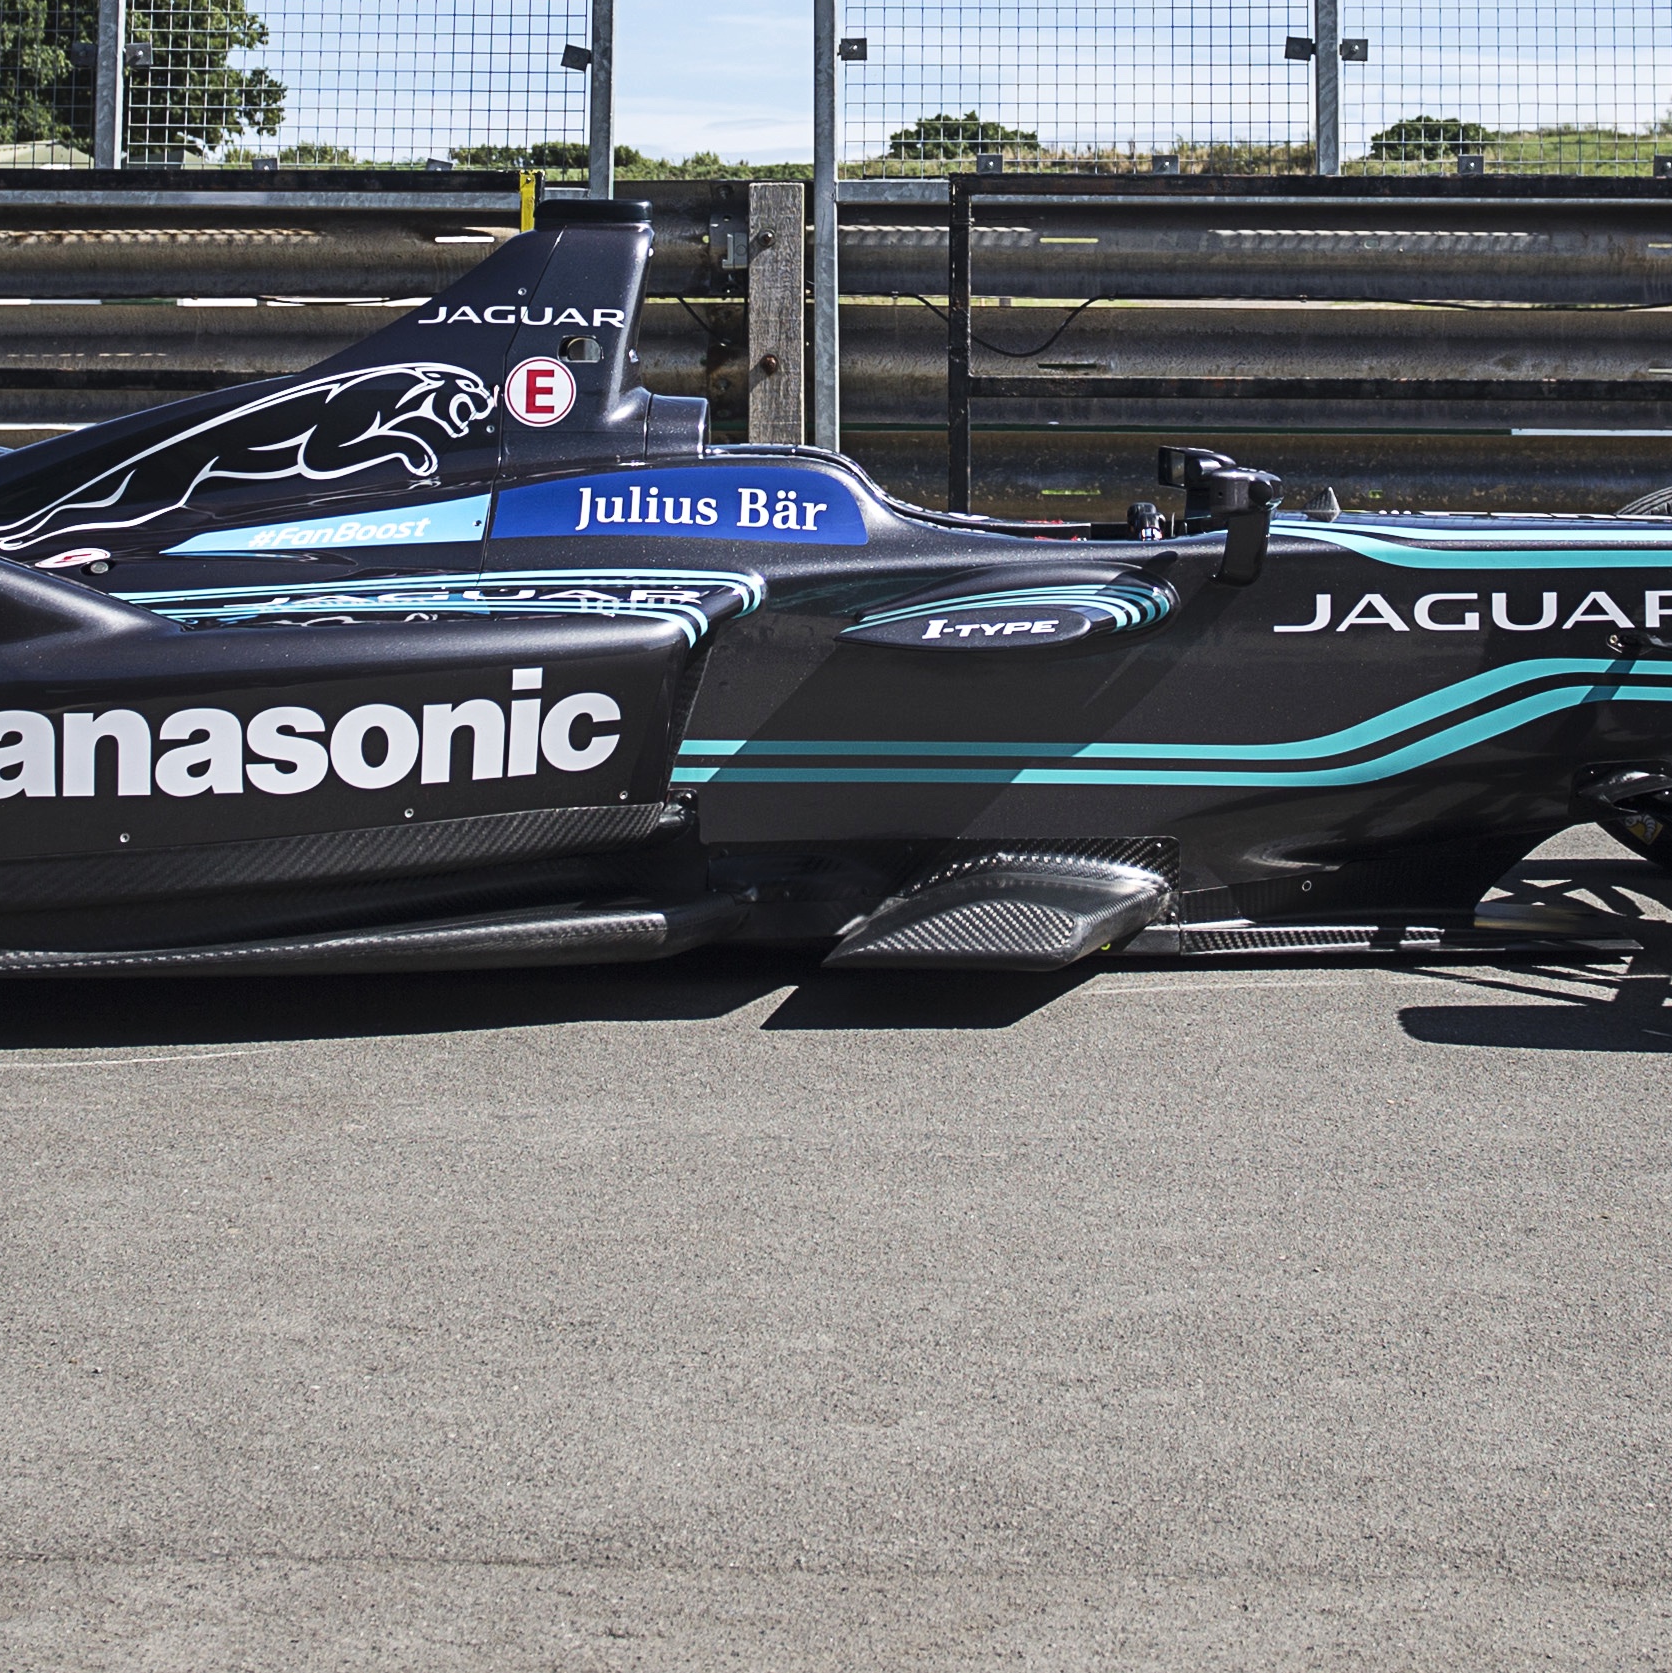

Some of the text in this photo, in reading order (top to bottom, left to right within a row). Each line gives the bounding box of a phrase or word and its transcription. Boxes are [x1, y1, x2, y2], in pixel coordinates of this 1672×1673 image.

[418, 305, 625, 327] JAGUAR
[525, 368, 555, 415] E
[574, 486, 828, 531] Julius Bär
[247, 516, 432, 548] #FanBoost
[921, 618, 1060, 640] I-TYPE
